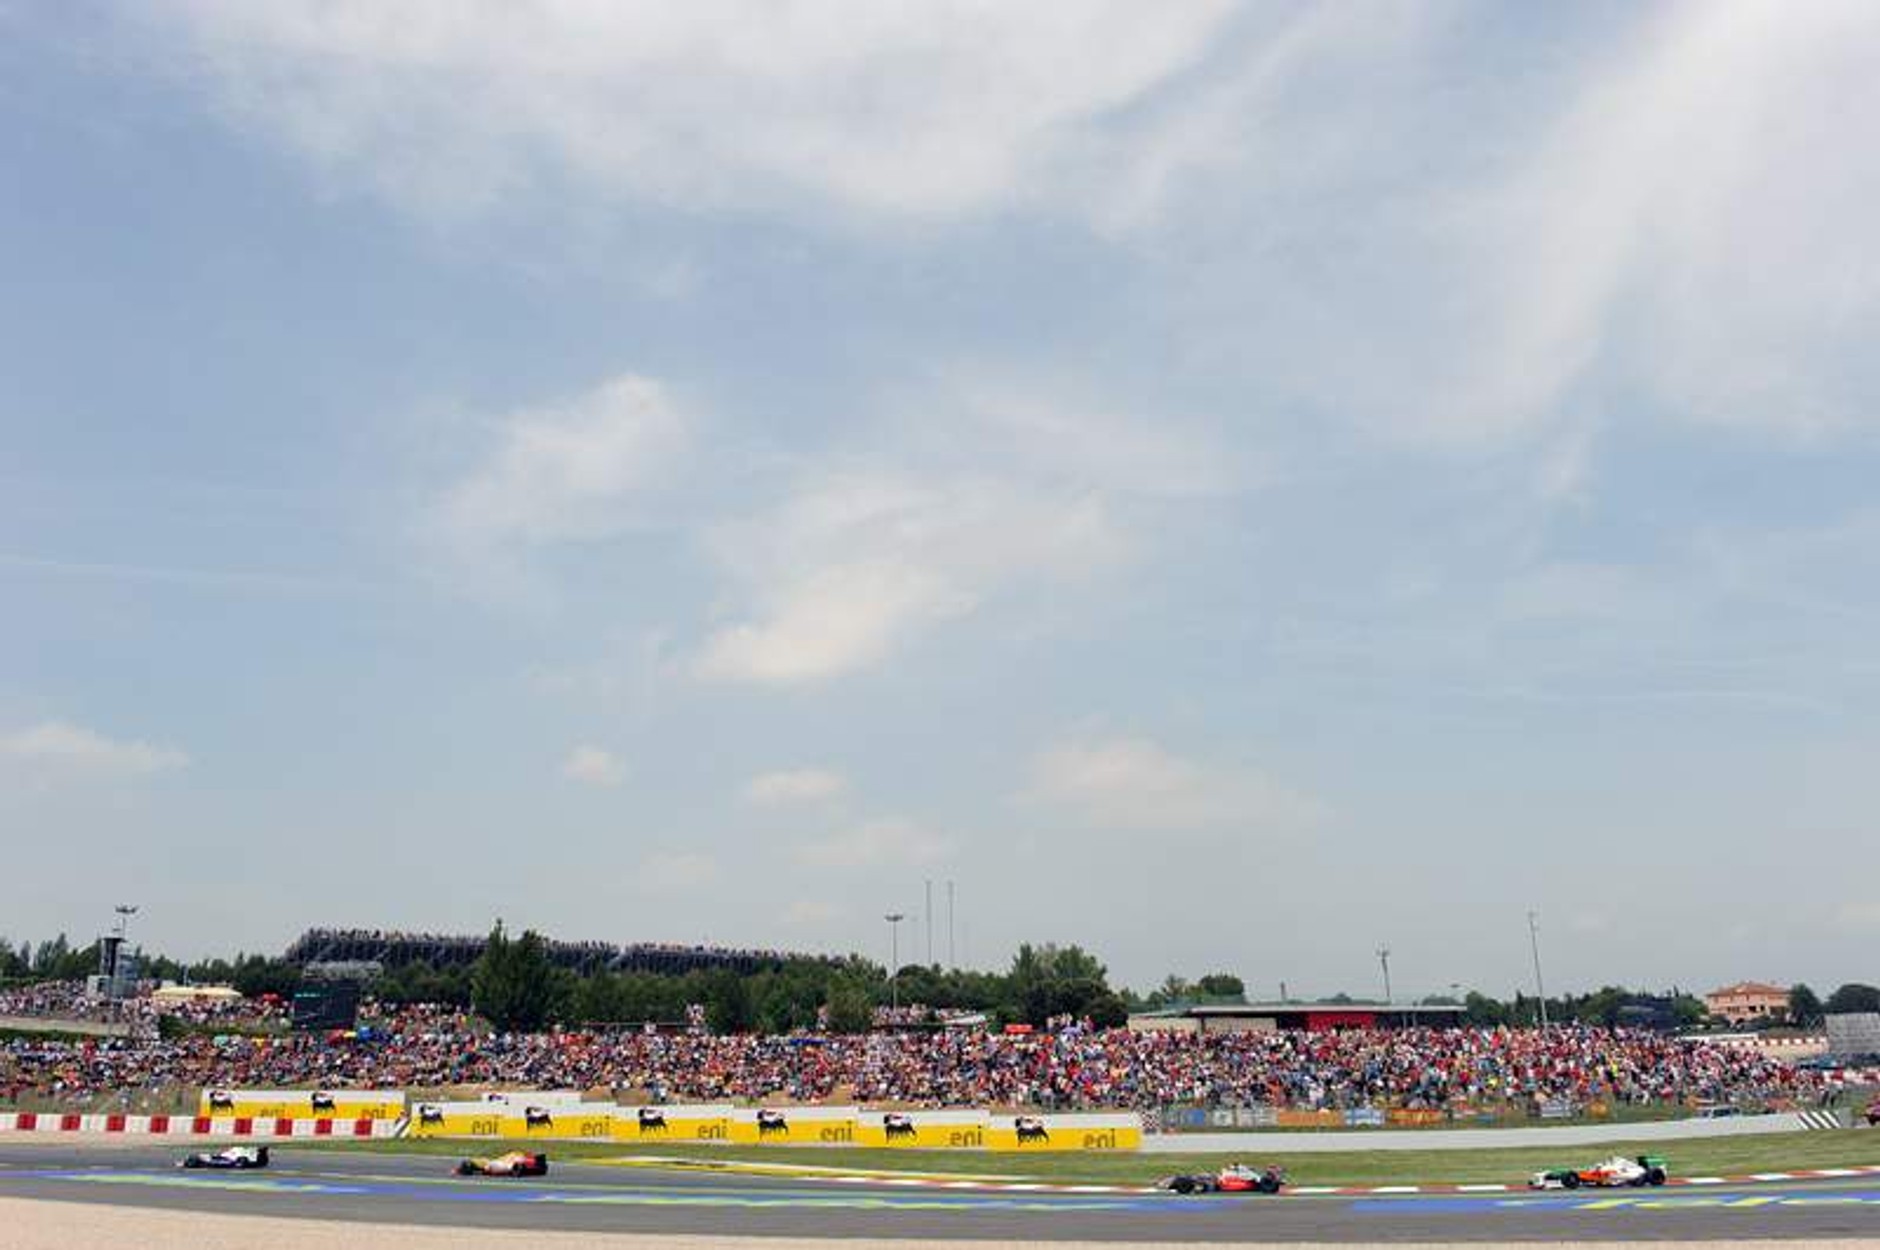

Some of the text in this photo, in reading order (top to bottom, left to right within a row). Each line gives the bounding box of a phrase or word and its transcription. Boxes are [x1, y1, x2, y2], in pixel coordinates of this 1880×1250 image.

[471, 1115, 501, 1135] eni
[580, 1115, 611, 1137] eni
[696, 1118, 727, 1140] eni
[820, 1121, 854, 1143] eni
[949, 1125, 984, 1147] eni
[1082, 1128, 1116, 1149] eni
